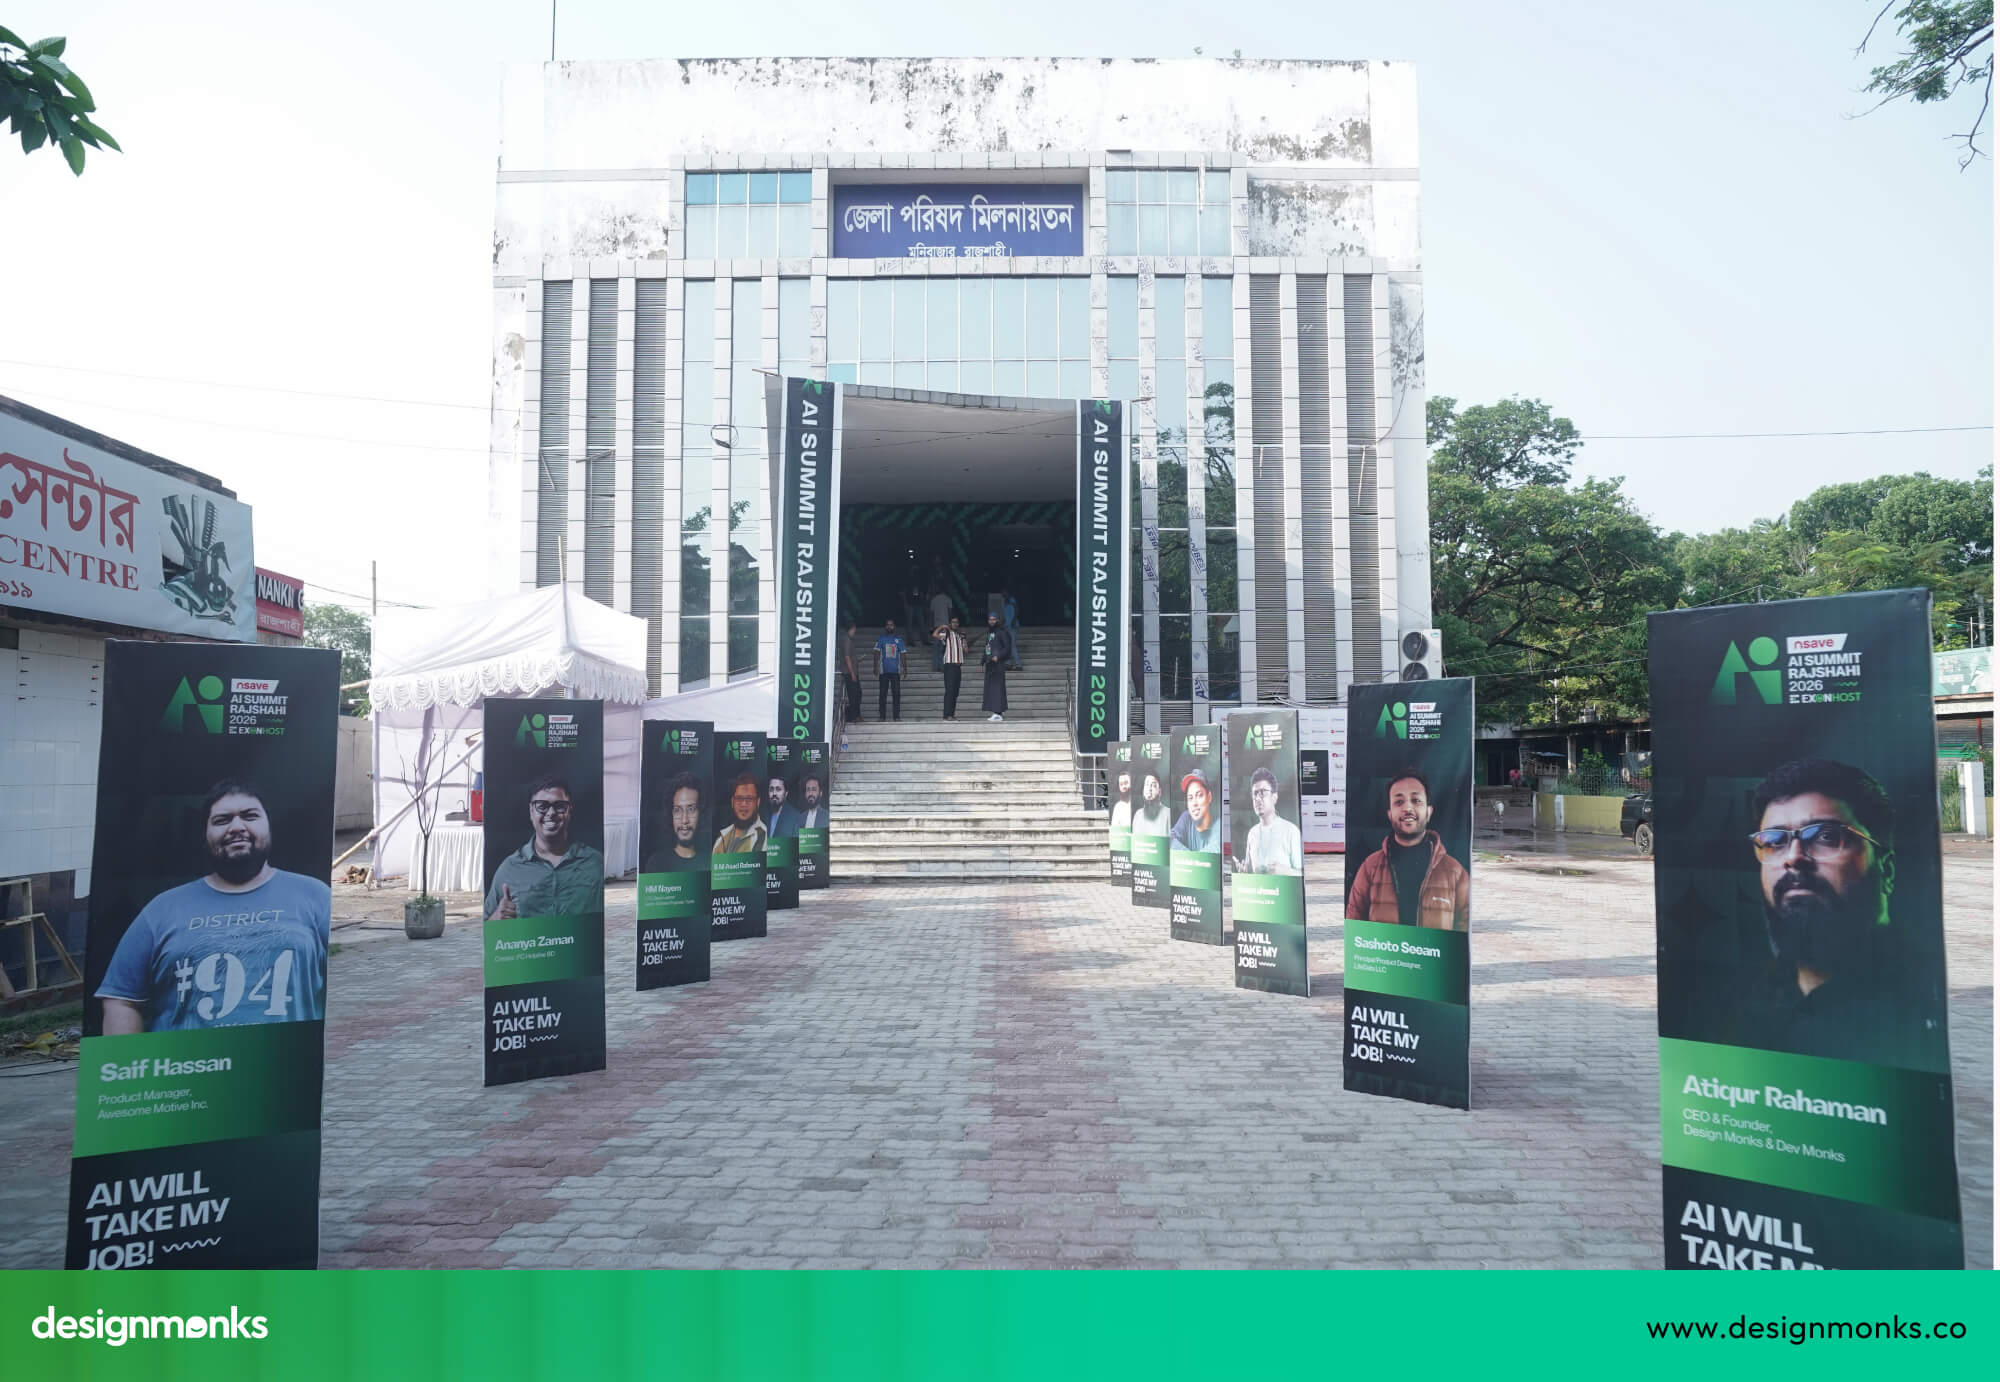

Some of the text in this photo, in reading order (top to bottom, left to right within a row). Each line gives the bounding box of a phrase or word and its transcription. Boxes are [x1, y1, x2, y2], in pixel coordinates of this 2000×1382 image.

[844, 194, 1074, 233] জেলা পরিষদ মিলনায়তন
[793, 400, 818, 740] AI SUMMIT RAJSHAHI 2026
[1090, 419, 1109, 738] AI SUMMIT RAJSHAHI 2026
[1794, 638, 1834, 649] nsave
[1788, 652, 1862, 667] AI SUMMIT
[1788, 665, 1861, 679] RAJSHAHI
[236, 681, 269, 690] nsave
[1789, 680, 1823, 691] 2026
[230, 694, 288, 705] AI SUMMIT
[229, 705, 286, 715] RAJSHAHI
[229, 715, 257, 725] 2026
[722, 896, 741, 905] WILL
[188, 909, 284, 931] DISTRICT
[712, 906, 733, 916] TAKE
[495, 936, 574, 951] Ananya Zaman
[642, 928, 678, 940] AI WILL
[1237, 931, 1272, 944] AI WILL
[642, 940, 684, 952] TAKE MY
[1238, 944, 1278, 958] TAKE MY
[1354, 936, 1440, 958] Sashoto Seeam
[642, 954, 663, 966] JOB!
[1238, 957, 1258, 968] JOB!
[492, 996, 552, 1016] AI WILL
[492, 1012, 562, 1034] TAKE MY
[1352, 1006, 1409, 1029] AI WILL
[492, 1034, 526, 1052] JOB!
[1351, 1024, 1420, 1050] TAKE MY
[1350, 1042, 1383, 1063] JOB!
[100, 1057, 232, 1082] Saif Hassan
[98, 1087, 192, 1106] Product Manager,
[1682, 1074, 1888, 1126] Atiqur Rahaman
[97, 1100, 208, 1120] Awesome Motive Inc.
[1683, 1108, 1773, 1134] CEO & Founder,
[1683, 1124, 1846, 1162] Design Monks & Dev Monks
[86, 1170, 210, 1210] AI WILL
[85, 1197, 230, 1241] TAKE MY
[1680, 1200, 1814, 1254] AI WILL
[86, 1240, 154, 1270] JOB!
[1680, 1233, 1774, 1270] TAKE
